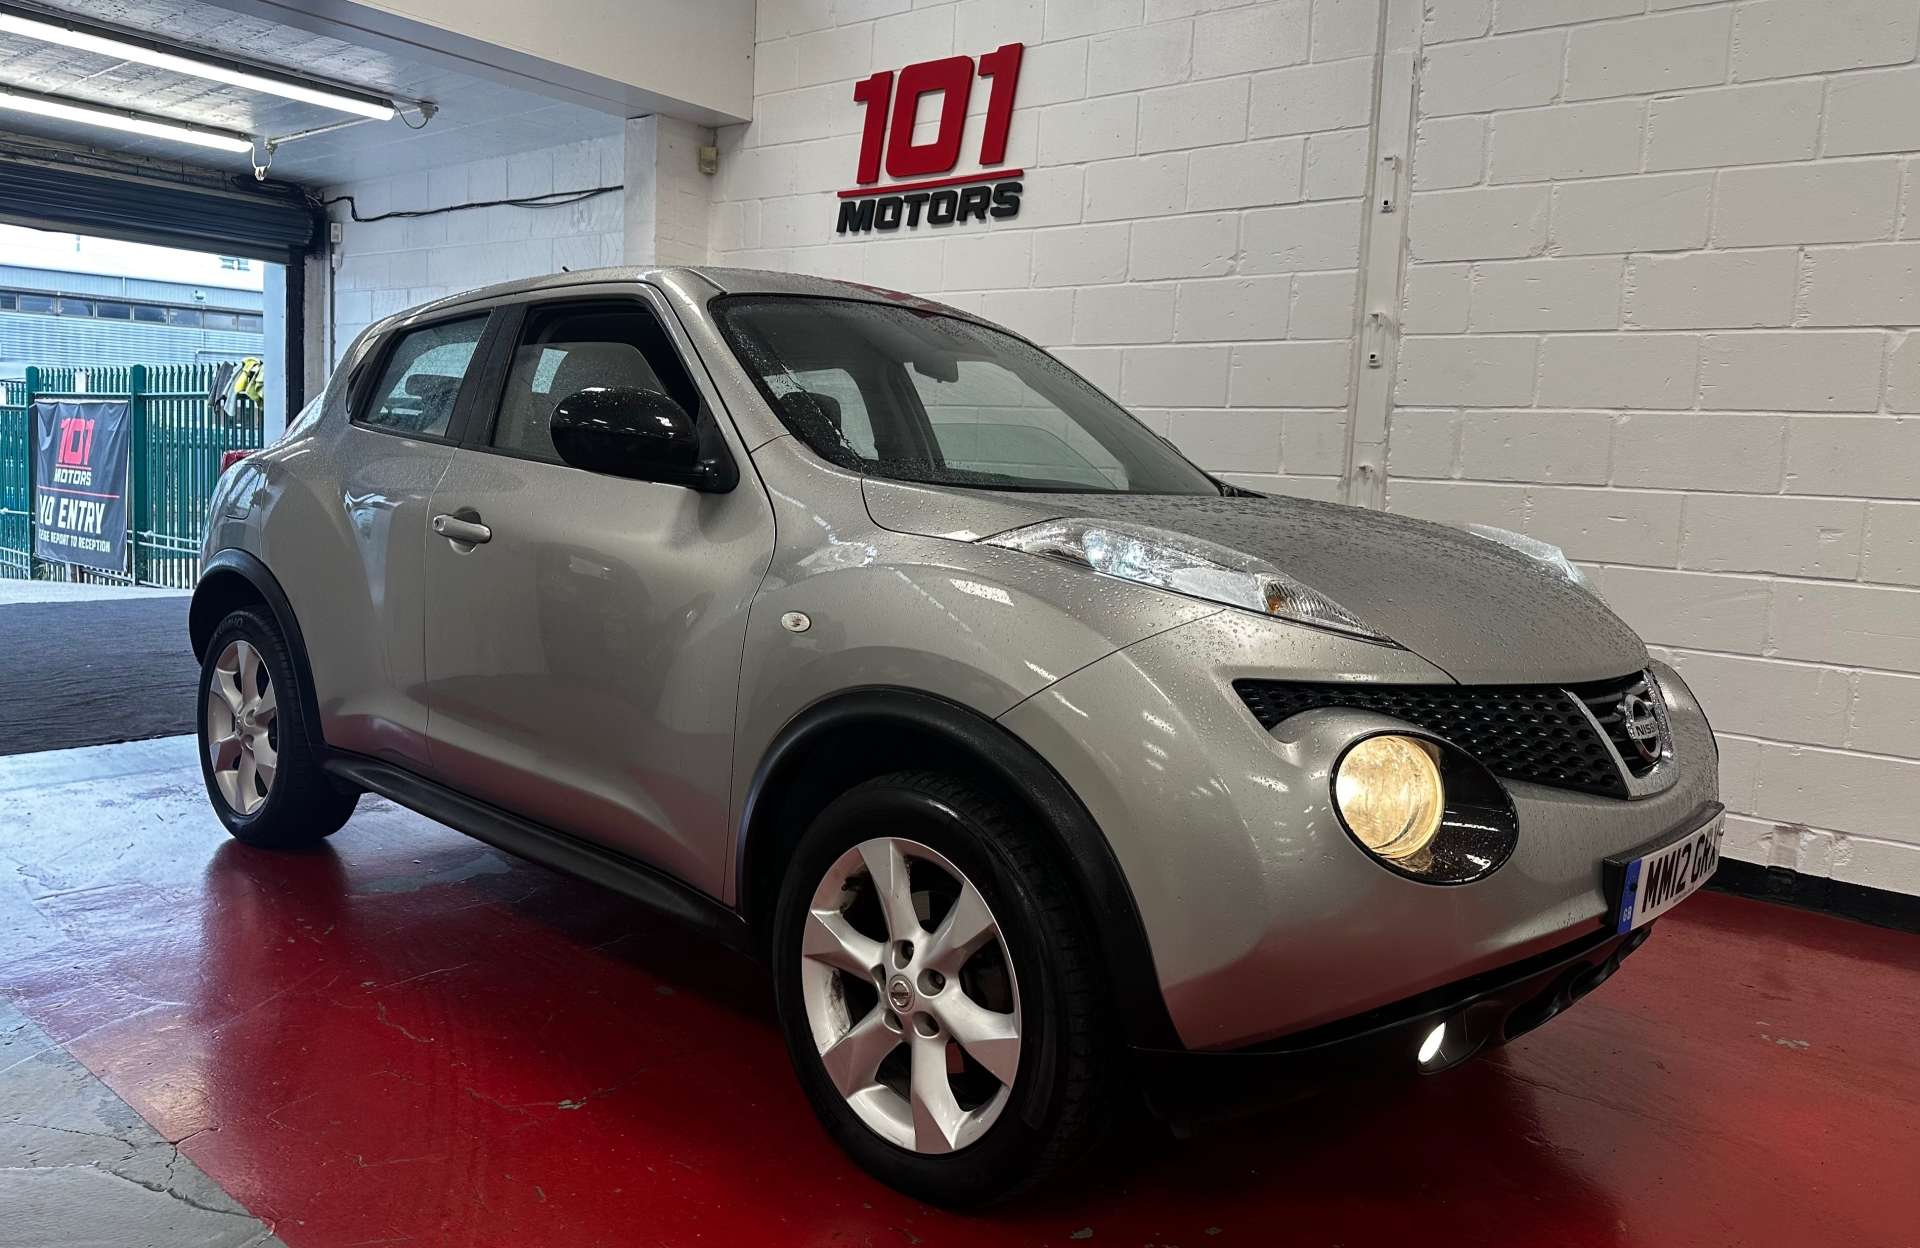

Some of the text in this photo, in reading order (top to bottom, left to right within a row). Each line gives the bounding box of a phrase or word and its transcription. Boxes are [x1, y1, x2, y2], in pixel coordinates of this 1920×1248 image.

[854, 43, 1024, 184] 101
[836, 182, 1023, 233] MOTORS
[58, 417, 95, 465] 101
[54, 468, 92, 486] MOTORS
[58, 497, 106, 534] ENTRY
[50, 531, 70, 546] REPORT
[70, 535, 78, 548] TO
[78, 536, 111, 553] RECEPTION
[1635, 722, 1658, 737] NISS
[1641, 843, 1692, 913] MM12
[1622, 905, 1633, 922] GB
